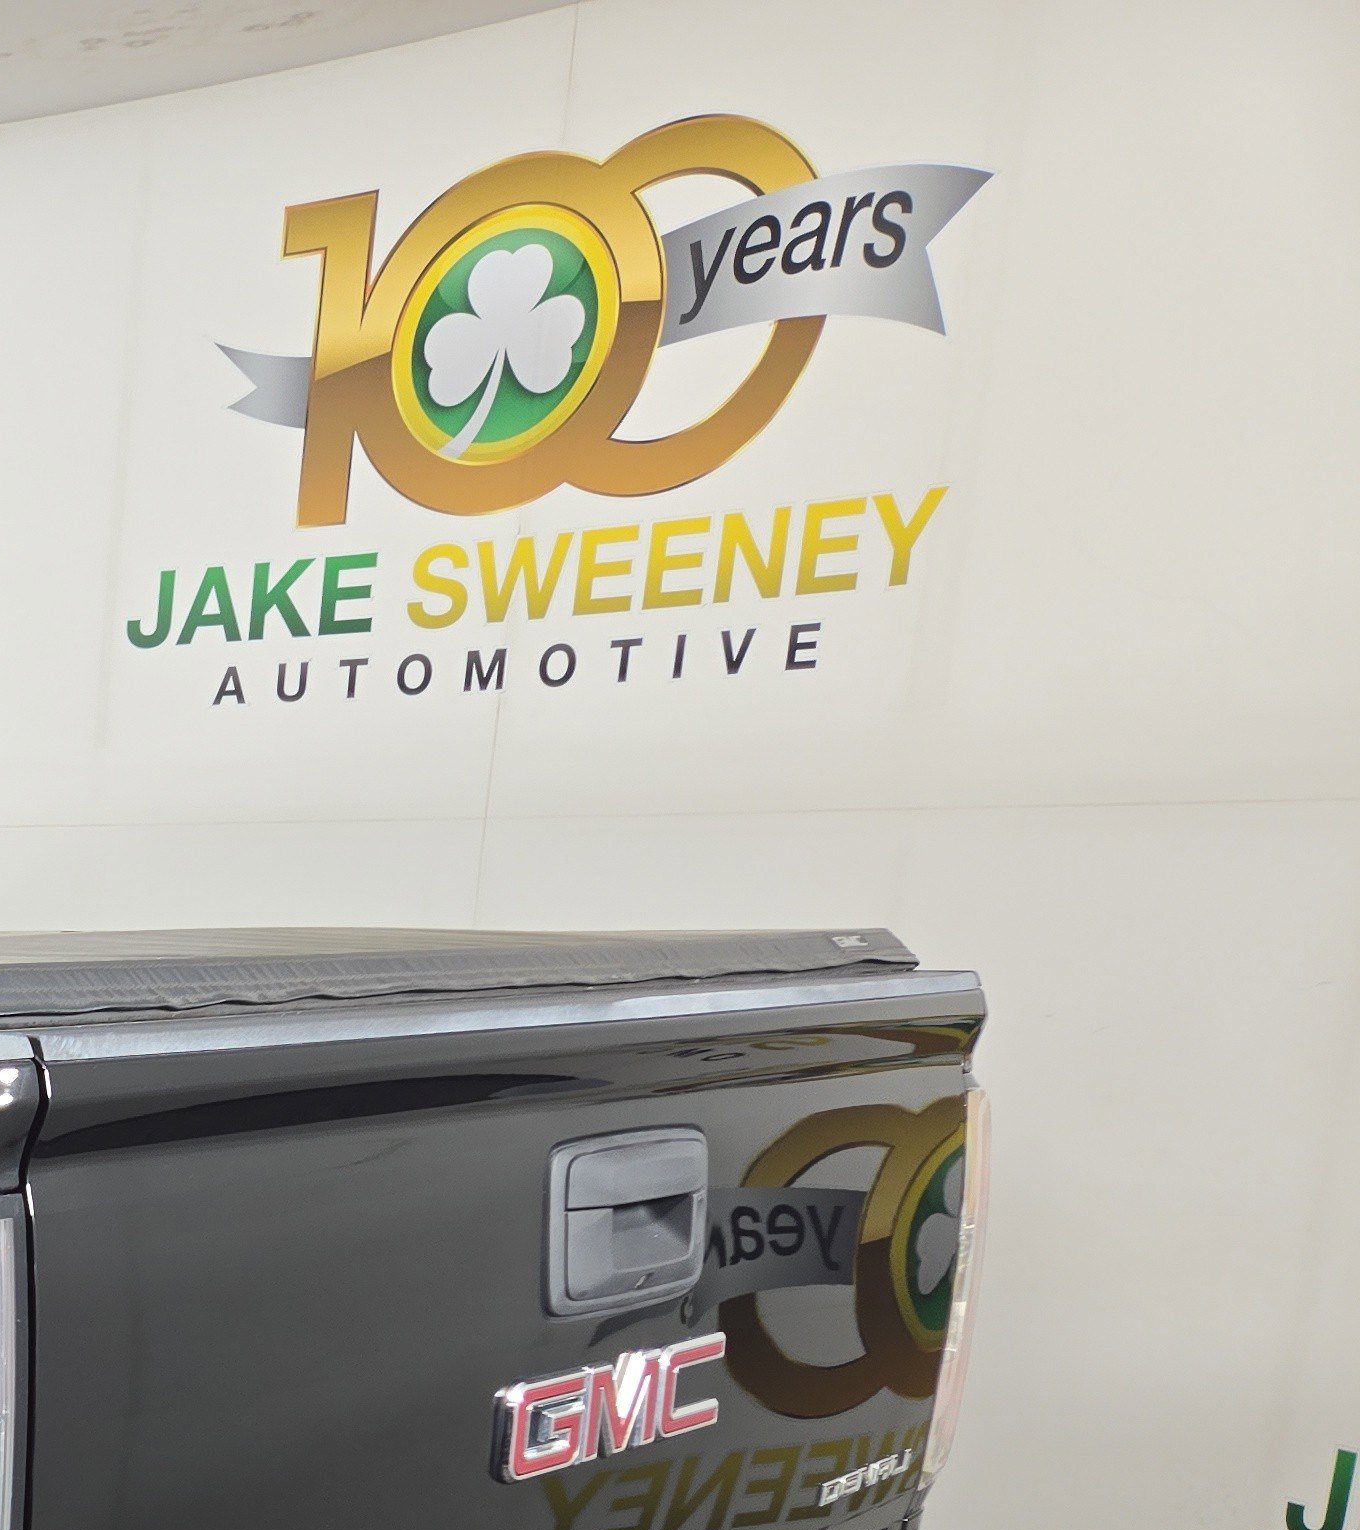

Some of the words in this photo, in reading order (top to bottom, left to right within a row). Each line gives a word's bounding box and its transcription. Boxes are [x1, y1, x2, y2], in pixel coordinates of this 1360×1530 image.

[282, 112, 827, 529] 100
[680, 190, 913, 326] years
[126, 551, 379, 650] JAKE
[406, 486, 950, 631] SWEENEY
[211, 622, 823, 707] AUTOMOTIVE
[492, 1331, 726, 1485] GMC
